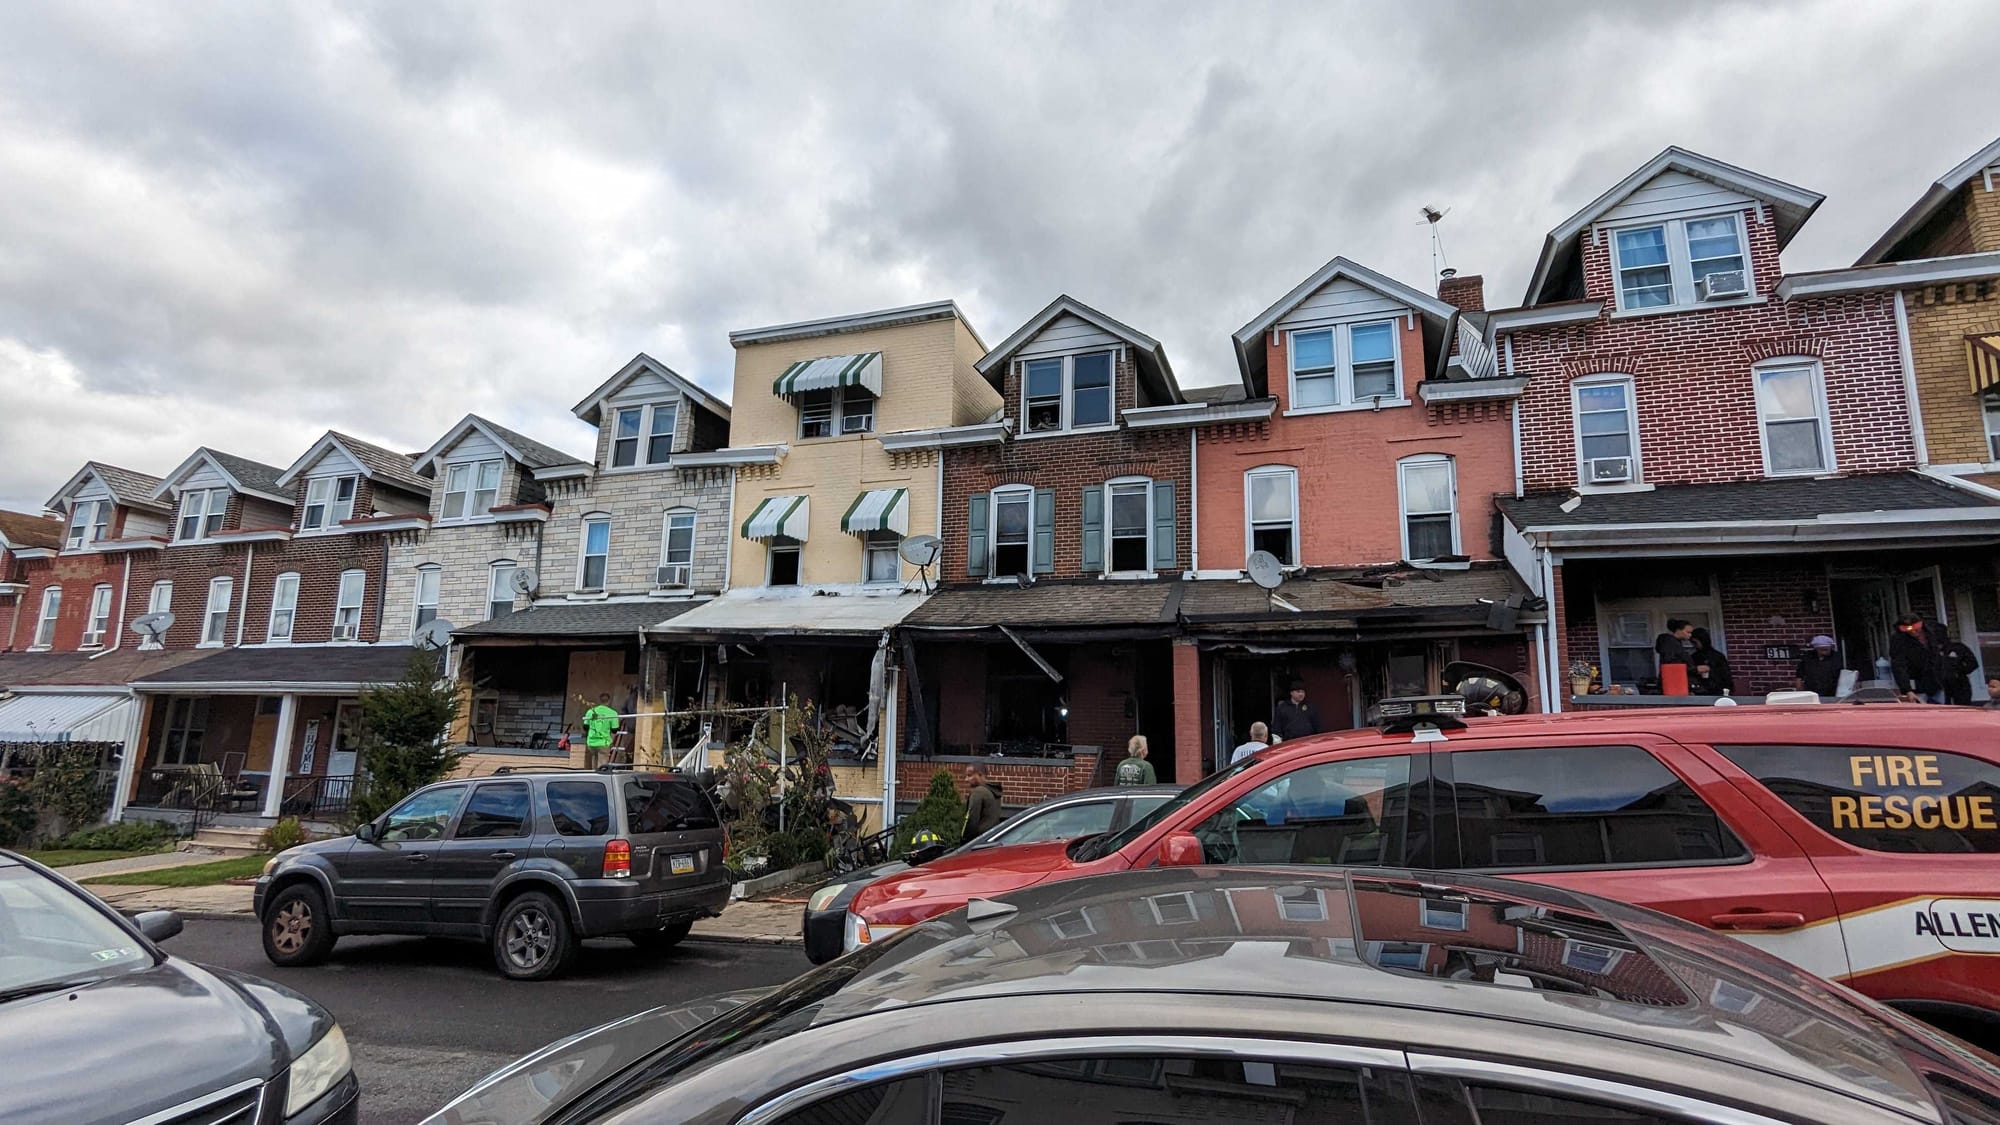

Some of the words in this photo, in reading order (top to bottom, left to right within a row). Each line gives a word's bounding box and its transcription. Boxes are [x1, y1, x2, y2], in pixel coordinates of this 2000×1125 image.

[302, 734, 315, 772] HOME
[1850, 755, 1942, 786] FIRE
[1831, 795, 1997, 829] RESCUE
